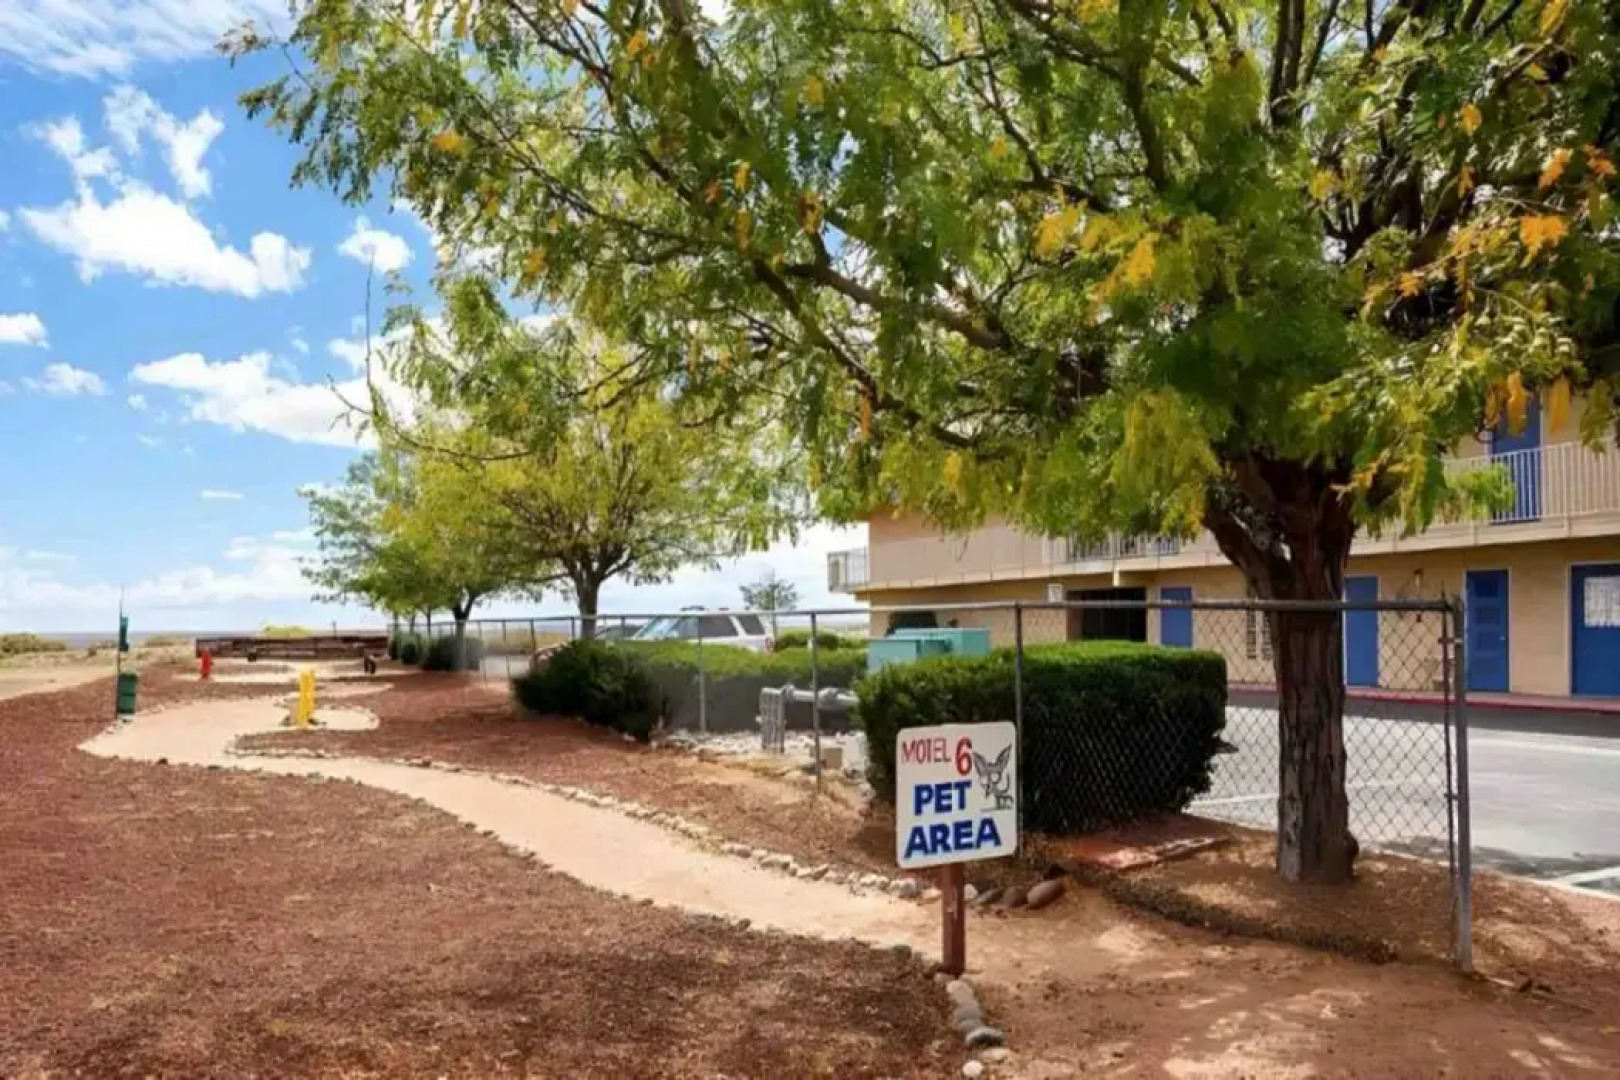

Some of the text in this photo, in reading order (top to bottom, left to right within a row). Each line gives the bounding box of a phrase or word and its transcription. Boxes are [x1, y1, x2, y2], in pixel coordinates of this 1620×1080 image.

[902, 737, 973, 776] MOTEL 6
[914, 779, 972, 816] PET
[903, 817, 1001, 859] AREA
